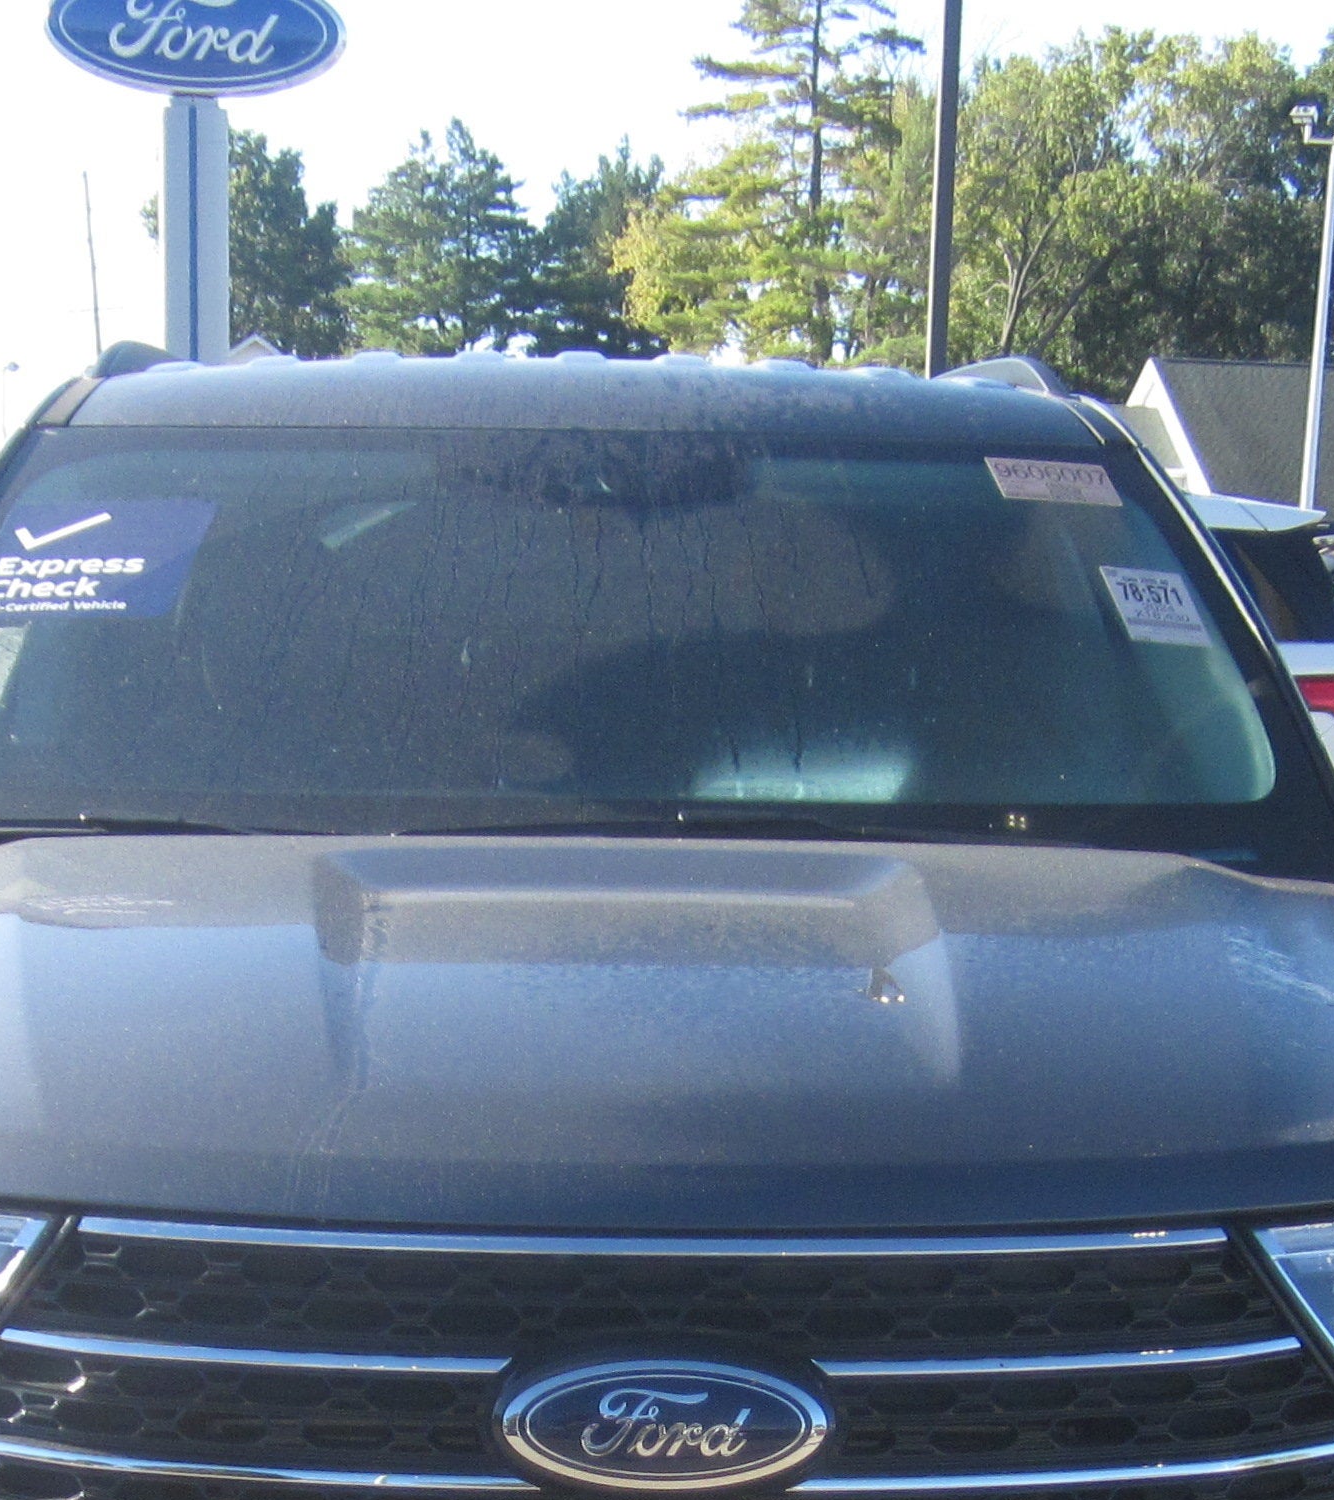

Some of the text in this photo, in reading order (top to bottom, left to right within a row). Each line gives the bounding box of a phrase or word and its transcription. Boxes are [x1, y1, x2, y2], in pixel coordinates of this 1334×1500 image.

[109, 0, 279, 64] Ford
[73, 600, 128, 611] Vehicle
[580, 1387, 752, 1457] Ford
